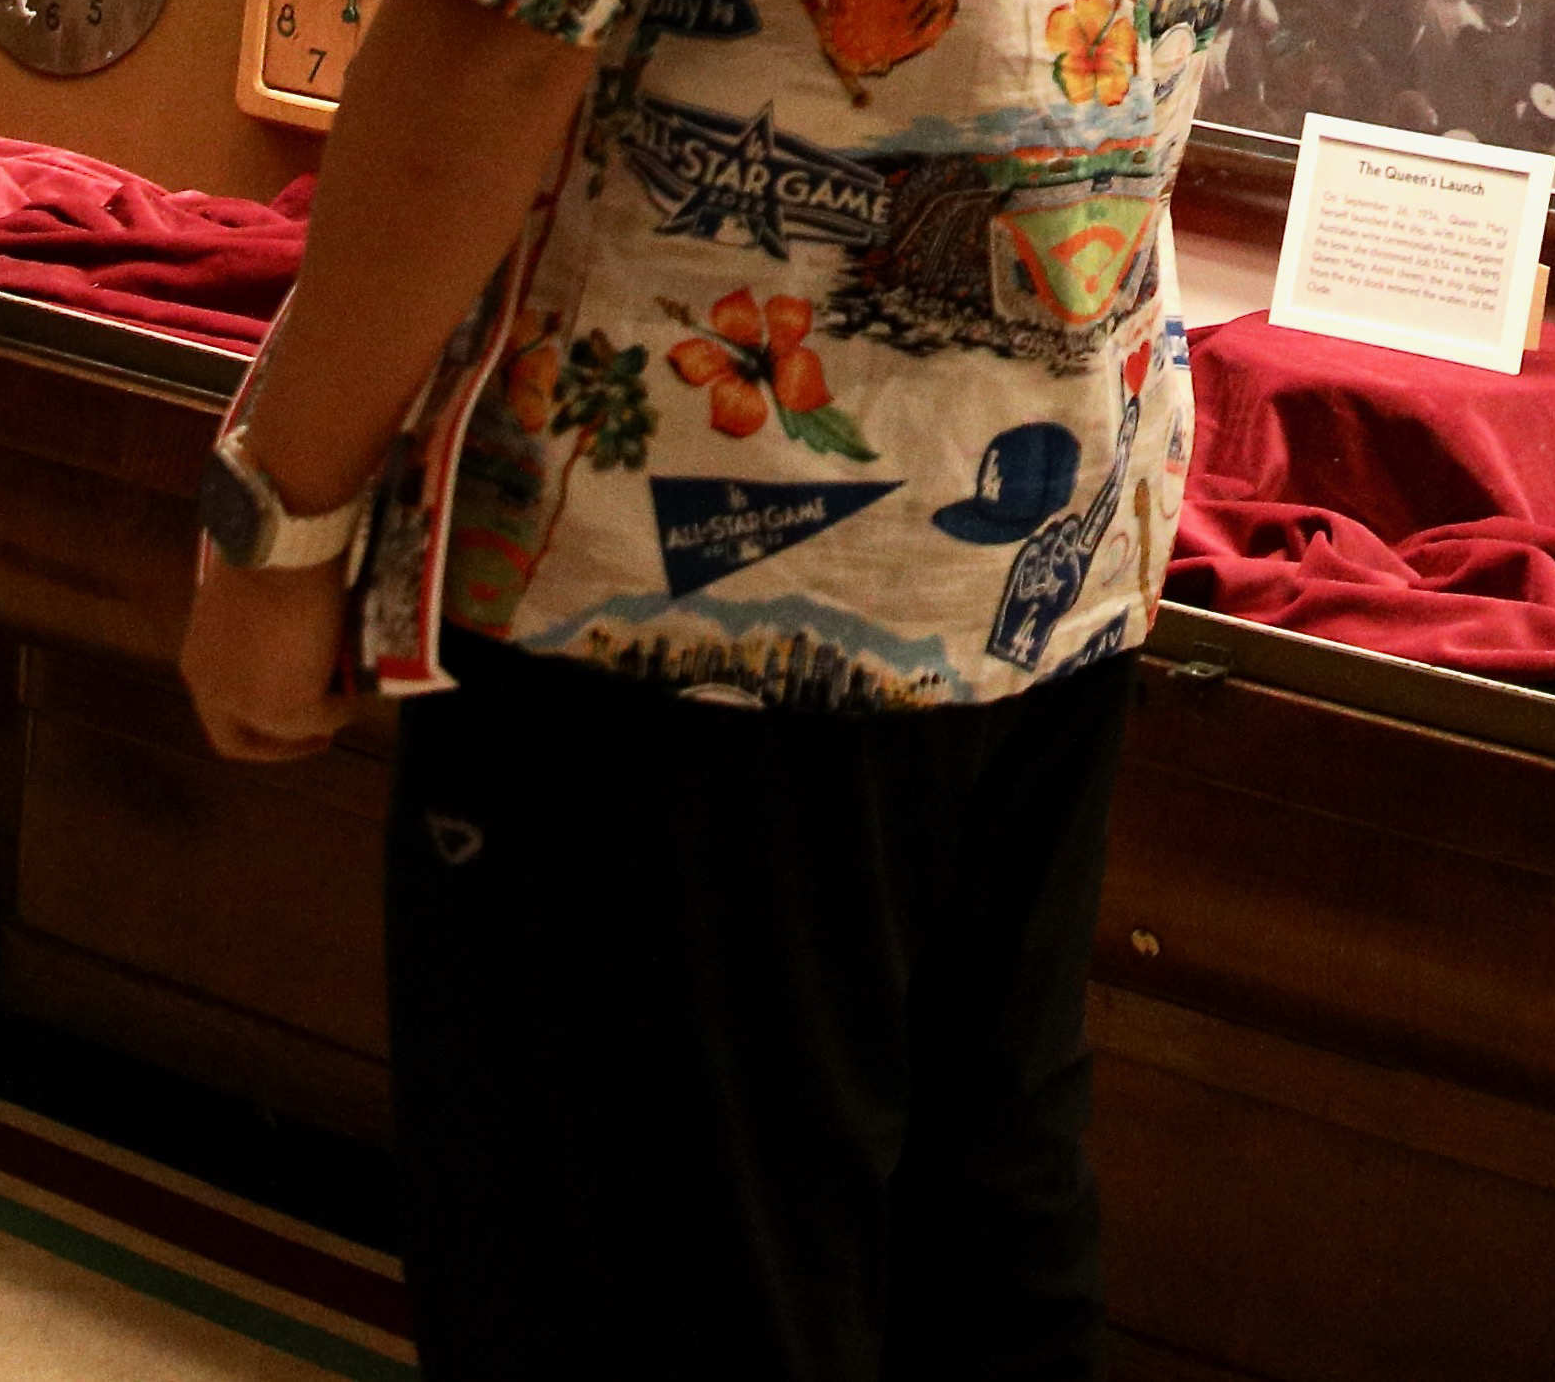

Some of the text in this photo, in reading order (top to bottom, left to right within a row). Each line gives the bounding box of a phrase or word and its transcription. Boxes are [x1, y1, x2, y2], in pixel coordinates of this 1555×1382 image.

[275, 2, 298, 37] 8
[308, 47, 326, 82] 7
[1358, 160, 1485, 196] The Queen's Launch
[776, 170, 893, 225] GAME
